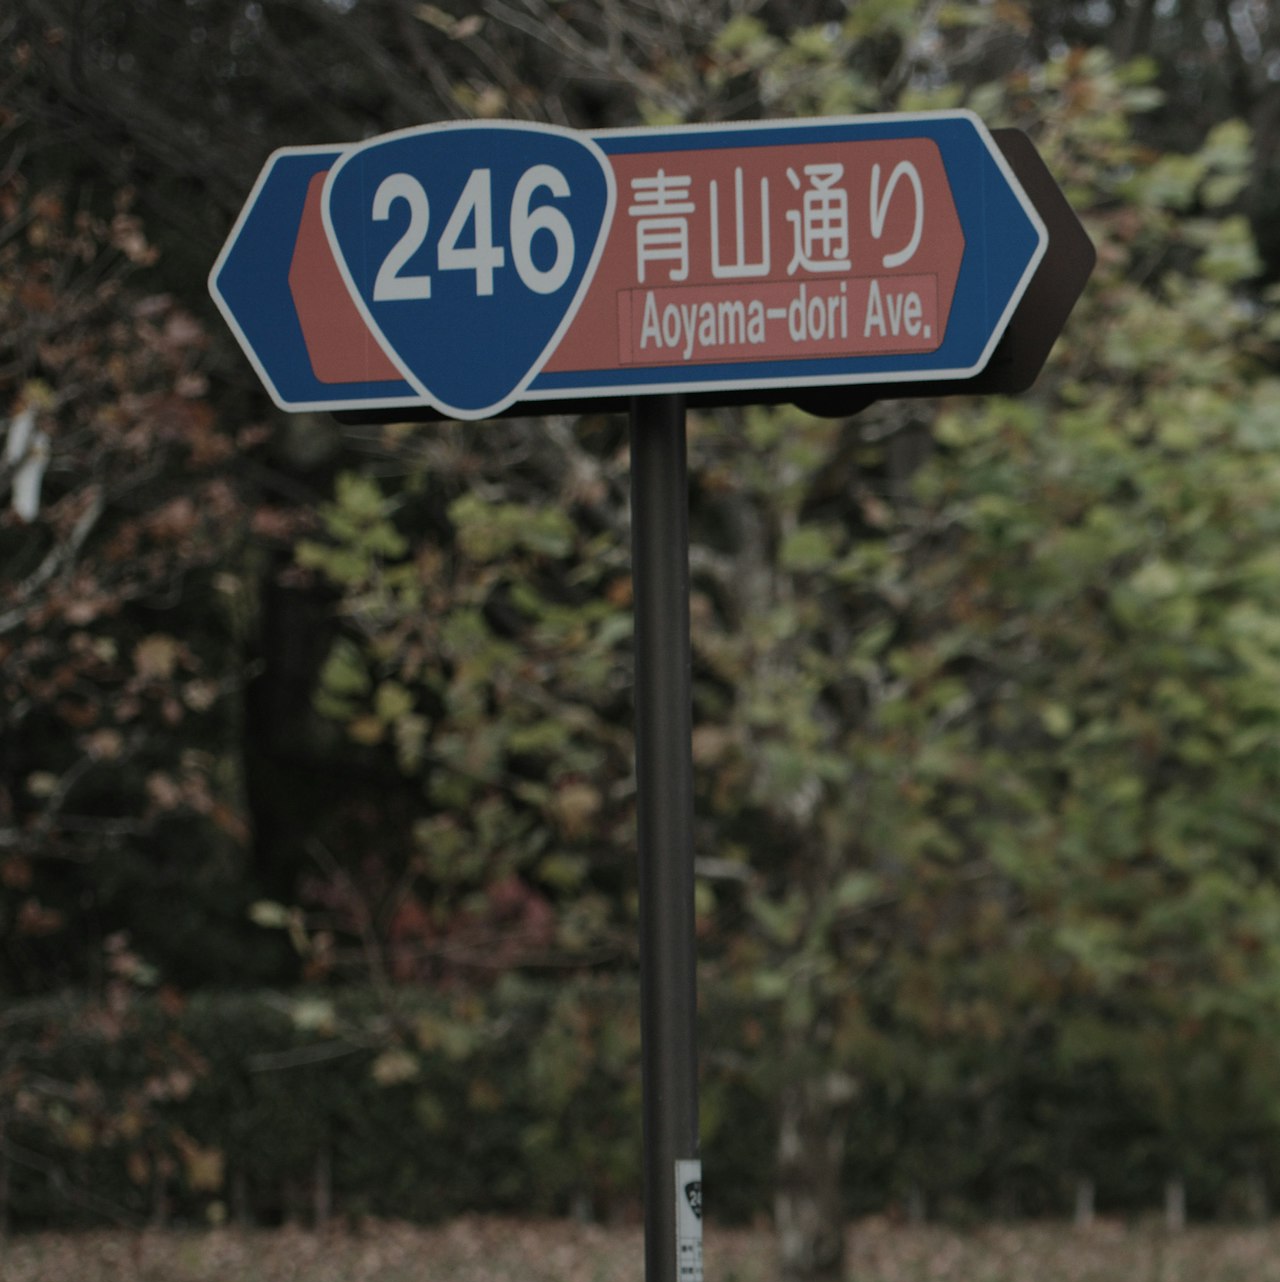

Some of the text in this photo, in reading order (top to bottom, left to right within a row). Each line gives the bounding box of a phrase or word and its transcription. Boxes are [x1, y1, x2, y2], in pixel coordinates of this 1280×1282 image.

[371, 163, 576, 302] 246
[628, 160, 925, 284] 青山通り
[640, 279, 932, 361] Aoyama-dori Ave.
